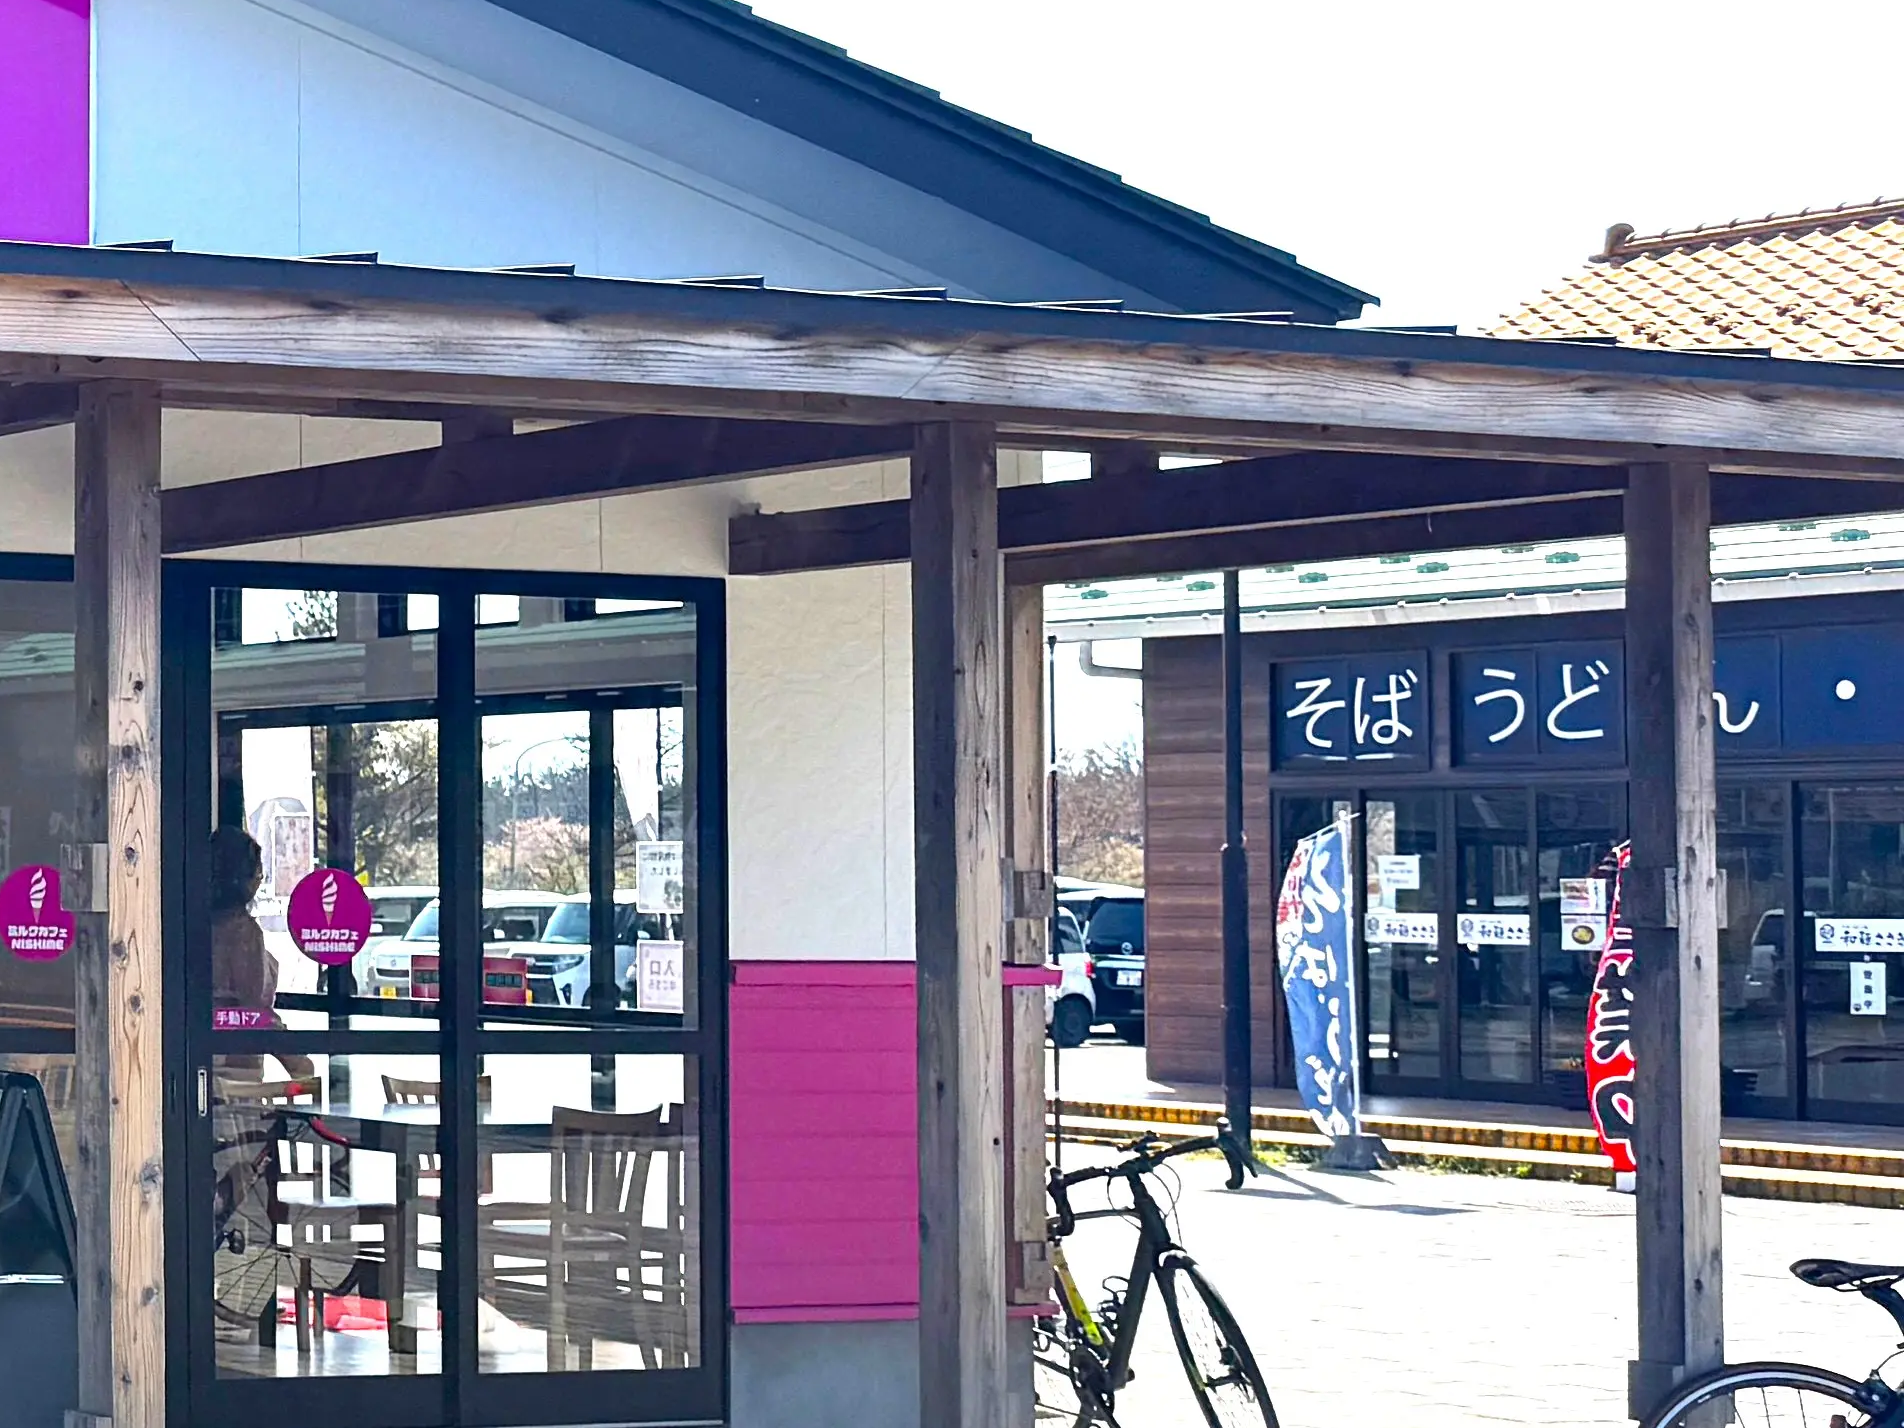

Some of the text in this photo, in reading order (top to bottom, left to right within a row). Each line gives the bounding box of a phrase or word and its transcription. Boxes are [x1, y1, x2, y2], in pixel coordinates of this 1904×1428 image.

[1286, 668, 1420, 749] そば
[8, 925, 68, 938] ミルクカフェ
[301, 928, 359, 941] ミルクカフェ
[11, 938, 64, 950] NISHIME
[215, 1010, 261, 1025] 手動ドア
